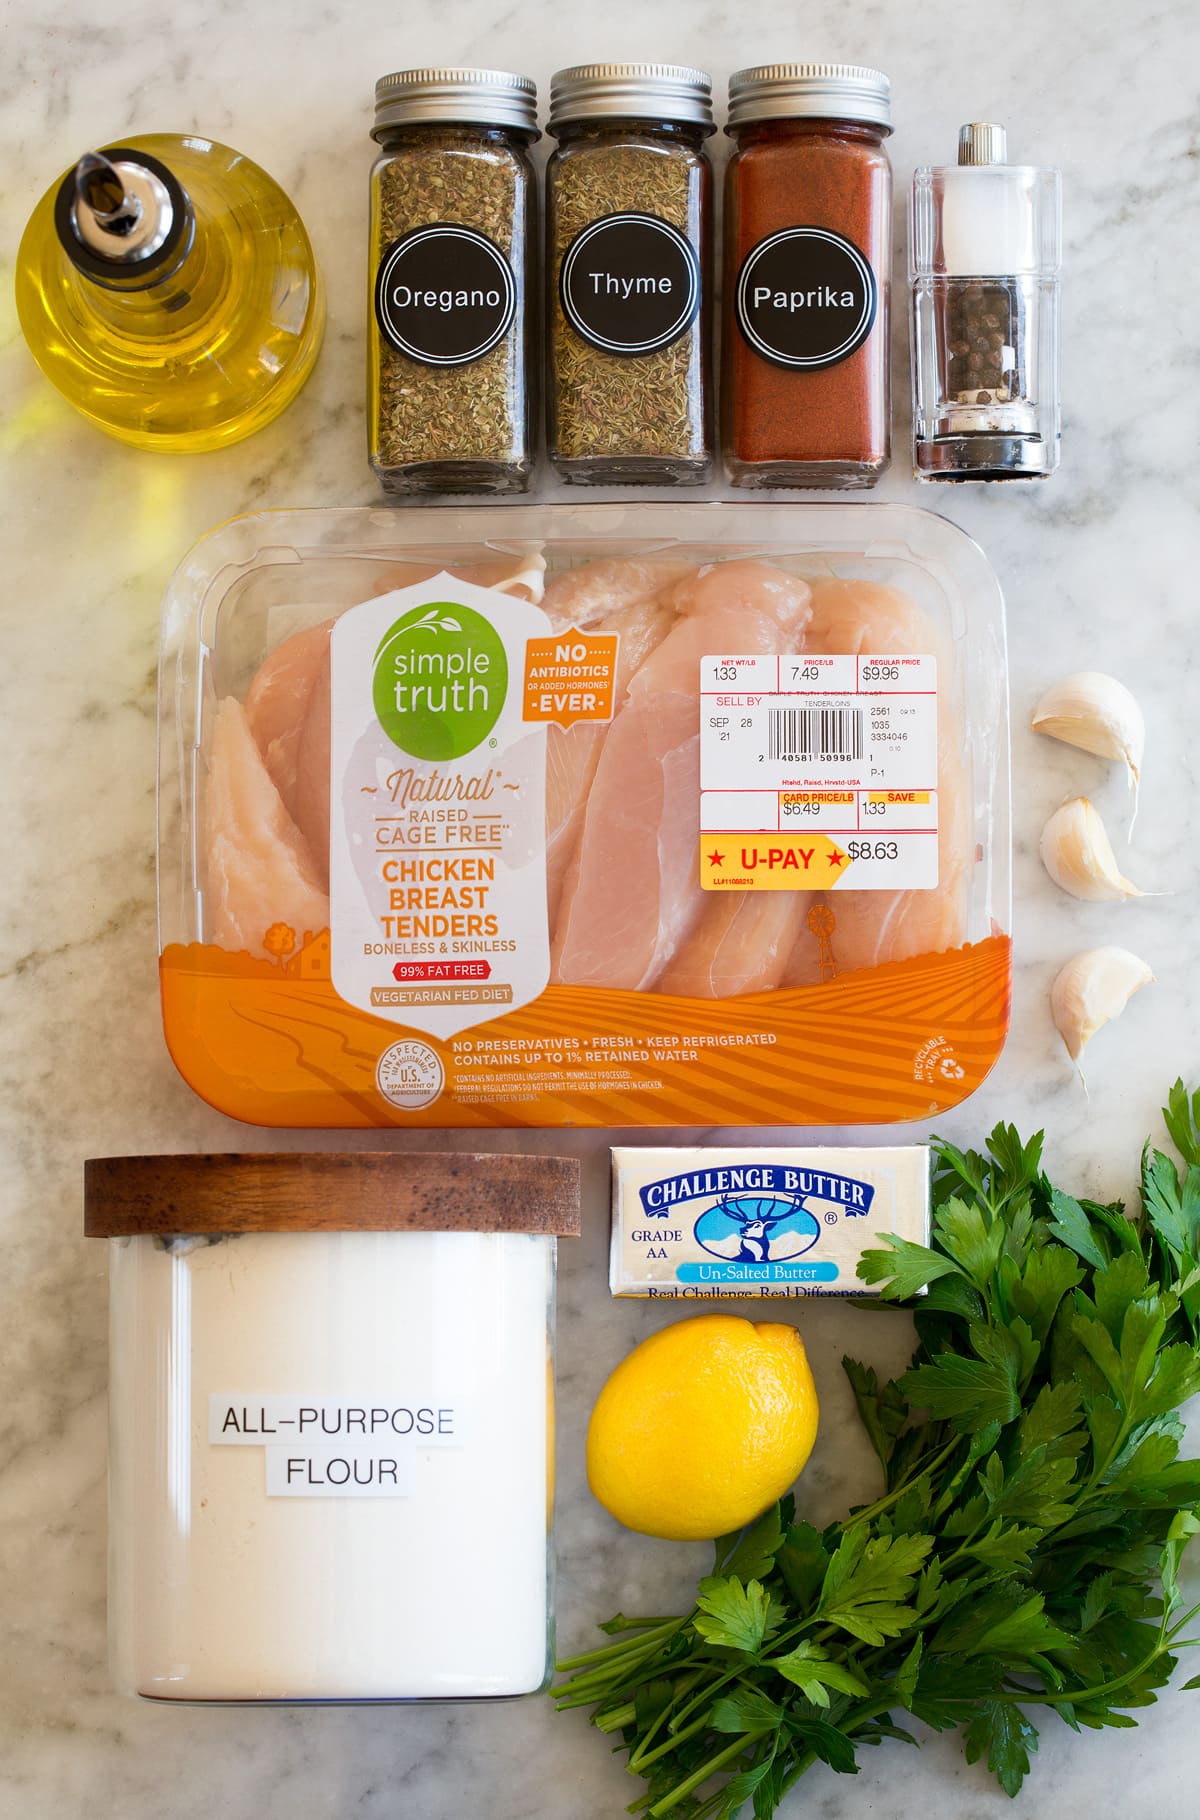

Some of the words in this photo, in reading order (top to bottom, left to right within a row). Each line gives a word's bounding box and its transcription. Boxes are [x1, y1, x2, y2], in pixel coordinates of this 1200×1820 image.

[589, 272, 673, 300] Thyme
[393, 287, 500, 312] Oregano
[753, 287, 855, 312] Paprika
[555, 644, 587, 662] NO
[394, 648, 490, 679] simple
[529, 665, 609, 678] ANTIBIOTICS
[791, 667, 819, 680] 7.49
[863, 666, 899, 681] $9.96
[540, 682, 565, 690] ADDED
[394, 678, 489, 713] truth
[716, 696, 743, 706] SELL
[747, 696, 762, 706] BY
[540, 694, 597, 712] EVER
[870, 707, 890, 715] 2561
[710, 718, 729, 728] SEP
[741, 718, 752, 728] 28
[871, 721, 890, 729] 1035
[870, 733, 908, 741] 3334046
[759, 754, 764, 762] 2
[782, 754, 812, 762] 40581
[820, 754, 852, 762] 50996
[871, 768, 885, 777] P-1
[783, 794, 809, 802] CARD
[812, 794, 854, 802] PRICE/LB
[888, 793, 915, 801] SAVE
[783, 801, 820, 815] $6.49
[409, 809, 468, 822] RAISED
[376, 826, 436, 844] CAGE
[741, 848, 815, 869] U-PAY
[848, 841, 898, 862] $8.63
[382, 858, 495, 882] CHICKEN
[389, 886, 489, 910] BREAST
[381, 914, 499, 939] TENDERS
[363, 942, 435, 955] BONELESS
[439, 942, 448, 953] &
[452, 940, 516, 952] SKINLESS
[400, 966, 424, 977] 99%
[427, 965, 450, 976] FAT
[454, 964, 484, 975] FREE
[373, 991, 450, 1003] VEGETARIAN
[454, 990, 478, 1001] FED
[482, 989, 510, 1000] DIET
[453, 1041, 472, 1052] NO
[477, 1038, 579, 1051] PRESERVATIVES
[592, 1036, 634, 1047] FRESH
[647, 1036, 679, 1047] KEEP
[683, 1034, 777, 1047] REFRIGERATED
[382, 1045, 437, 1074] INSPECTED
[454, 1054, 520, 1066] CONTAINS
[525, 1053, 541, 1063] UP
[545, 1053, 563, 1063] TO
[566, 1052, 582, 1063] 1%
[585, 1051, 649, 1062] RETAINED
[653, 1050, 698, 1061] WATER
[914, 1036, 947, 1080] RECYCLABLE
[925, 1050, 942, 1069] TRAY
[401, 1069, 420, 1082] U.S.
[647, 1168, 774, 1209] CHALLENGE
[783, 1169, 866, 1208] BUTTER
[631, 1230, 682, 1242] GRADE
[646, 1248, 668, 1259] AA
[699, 1266, 770, 1281] Un-Salted
[774, 1266, 817, 1280] Butter
[648, 1287, 678, 1298] Real
[759, 1286, 790, 1298] Real
[795, 1286, 865, 1298] Difference
[222, 1407, 454, 1434] ALL-PURPOSE
[287, 1458, 397, 1485] FLOUR
